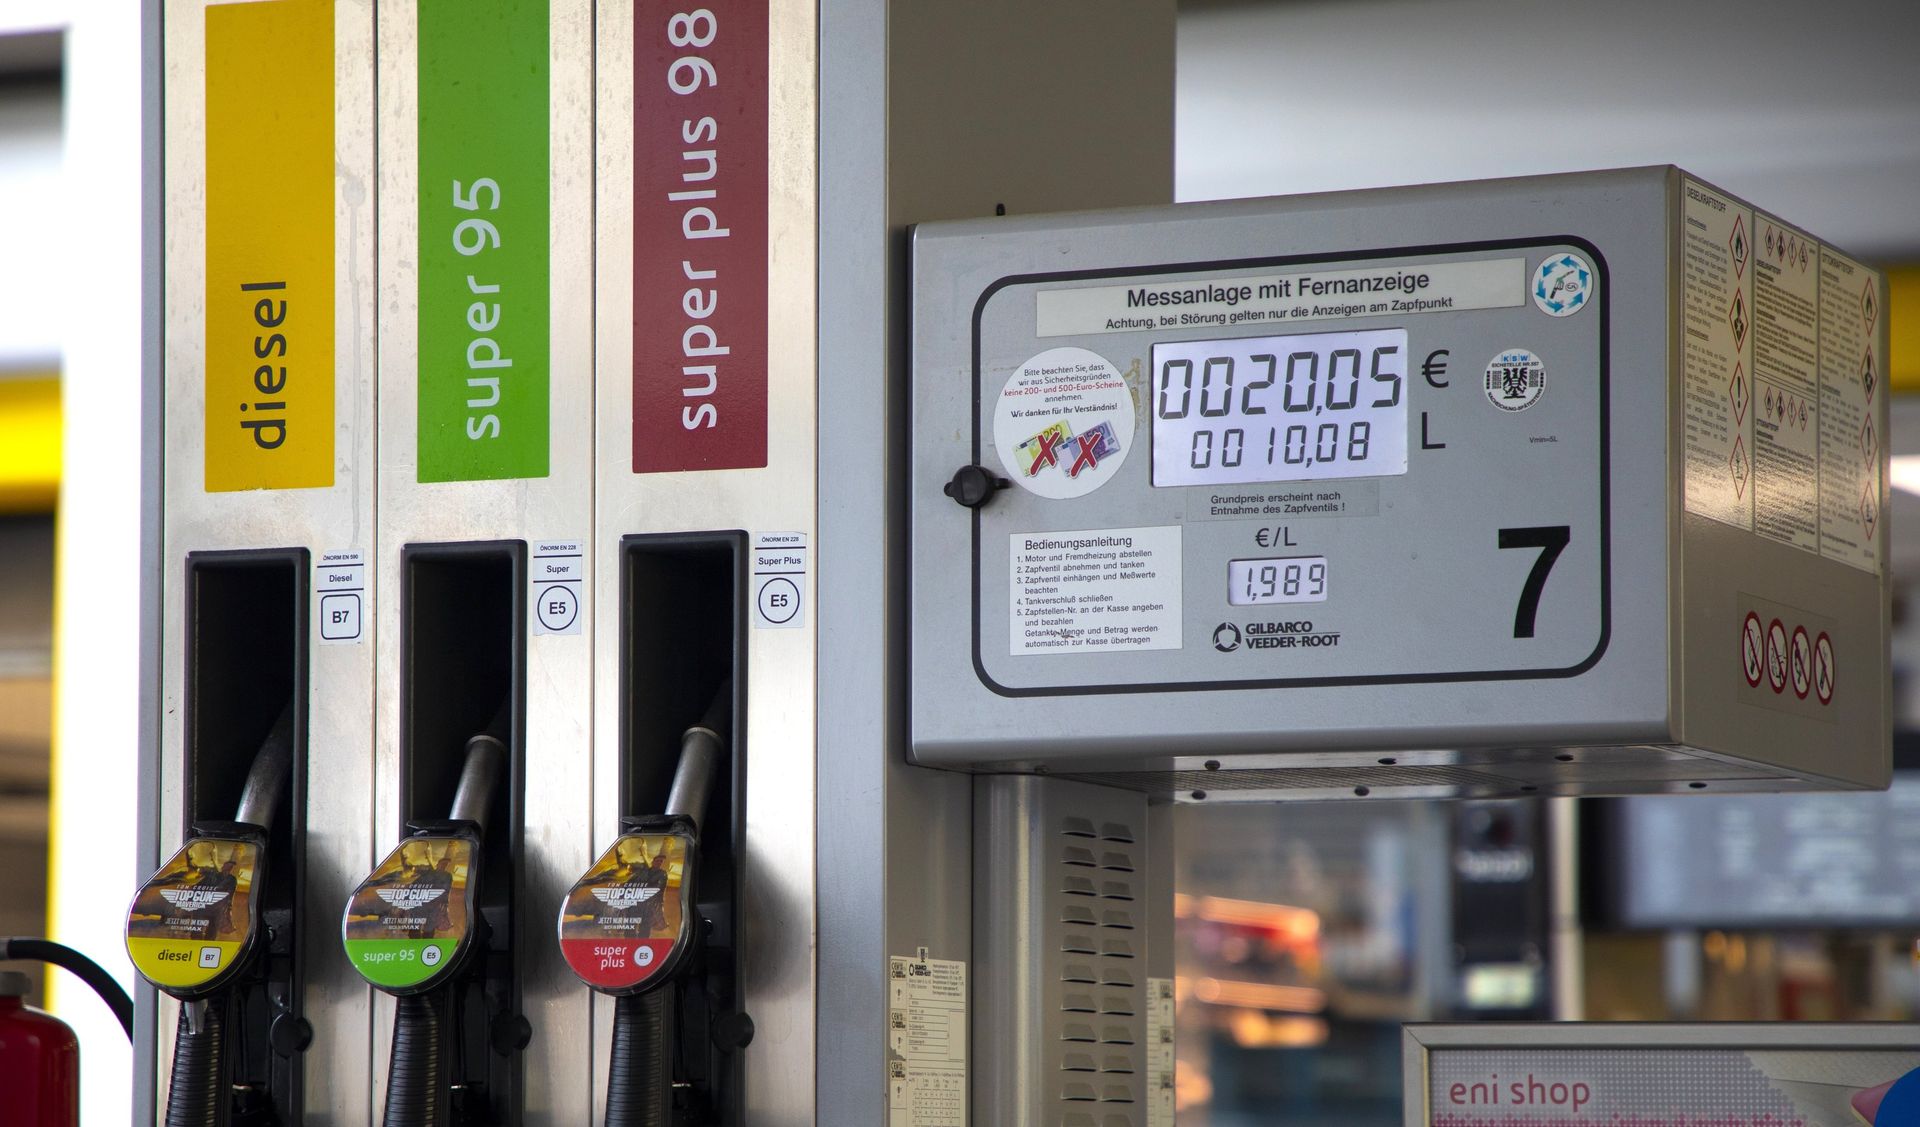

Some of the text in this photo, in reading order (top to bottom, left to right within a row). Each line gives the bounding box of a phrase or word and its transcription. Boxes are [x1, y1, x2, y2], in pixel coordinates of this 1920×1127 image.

[667, 8, 730, 430] super plus 98
[1127, 271, 1429, 308] Messanlage mit Fernanzeige
[453, 176, 512, 439] super 95
[1105, 296, 1452, 329] Achtung, bei Störung gelten nur die Anzeigen am Zapfpunkt
[240, 280, 287, 450] diesel
[1024, 368, 1040, 376] Bitte
[1041, 367, 1074, 375] beachten
[1075, 364, 1088, 373] Sie,
[1421, 349, 1450, 388] €
[1044, 372, 1111, 384] Sicherheitsgründen
[1158, 345, 1401, 420] 0020,05
[1004, 381, 1124, 397] keine 200- und 500-Euro-Scheine
[1044, 393, 1083, 403] annehmen.
[1025, 407, 1051, 416] danken
[1052, 406, 1062, 415] für
[1063, 405, 1073, 414] Ihr
[1074, 403, 1118, 413] Verständnis!
[1421, 411, 1446, 450] L
[1190, 421, 1370, 470] 0010,08
[1210, 491, 1341, 506] Grundpreis erscheint nach
[1210, 505, 1259, 515] Entnahme
[1263, 504, 1281, 514] des
[1284, 502, 1339, 515] Zapfventils
[1024, 536, 1132, 551] Bedienungsanleitung
[758, 556, 802, 566] Super Plus
[1025, 555, 1046, 563] Motor
[1065, 552, 1117, 562] Fremdheizung
[1119, 550, 1152, 558] abstellen
[546, 565, 570, 574] Super
[1025, 565, 1061, 576] Zapfventil
[1063, 563, 1101, 572] abnehmen
[1120, 561, 1145, 569] tanken
[329, 574, 353, 583] Diesel
[1025, 575, 1061, 586] Zapfventil
[1063, 573, 1100, 583] einhängen
[1103, 572, 1117, 580] und
[1120, 571, 1156, 580] Meßwerte
[1246, 564, 1325, 601] 1,989
[1498, 526, 1570, 639] 7
[1025, 586, 1058, 595] beachten
[771, 594, 788, 607] E5
[1016, 594, 1113, 606] 4. Tankverschluß schließen
[549, 602, 566, 614] E5
[1025, 606, 1078, 618] Zapfstellen-Nr.
[1091, 605, 1104, 613] der
[1107, 604, 1130, 613] Kasse
[1131, 603, 1164, 613] angeben
[332, 611, 349, 623] B7
[1041, 617, 1074, 625] bezahlen
[1060, 628, 1085, 638] Menge
[1104, 625, 1129, 636] Betrag
[1131, 624, 1158, 633] werden
[1245, 620, 1313, 635] GILBARCO
[1025, 638, 1069, 648] automatisch
[1085, 637, 1108, 645] Kasse
[1110, 636, 1150, 646] übertragen
[1245, 634, 1341, 649] VEEDER-ROOT
[175, 890, 215, 902] TOP GUN
[391, 889, 431, 900] TOP GUN
[606, 888, 646, 899] TOP GUN
[175, 901, 206, 909] MAVERICK
[158, 949, 192, 961] diesel
[363, 949, 415, 964] super 95
[594, 946, 627, 958] super
[600, 956, 625, 971] plus
[1449, 1074, 1591, 1112] eni shop
